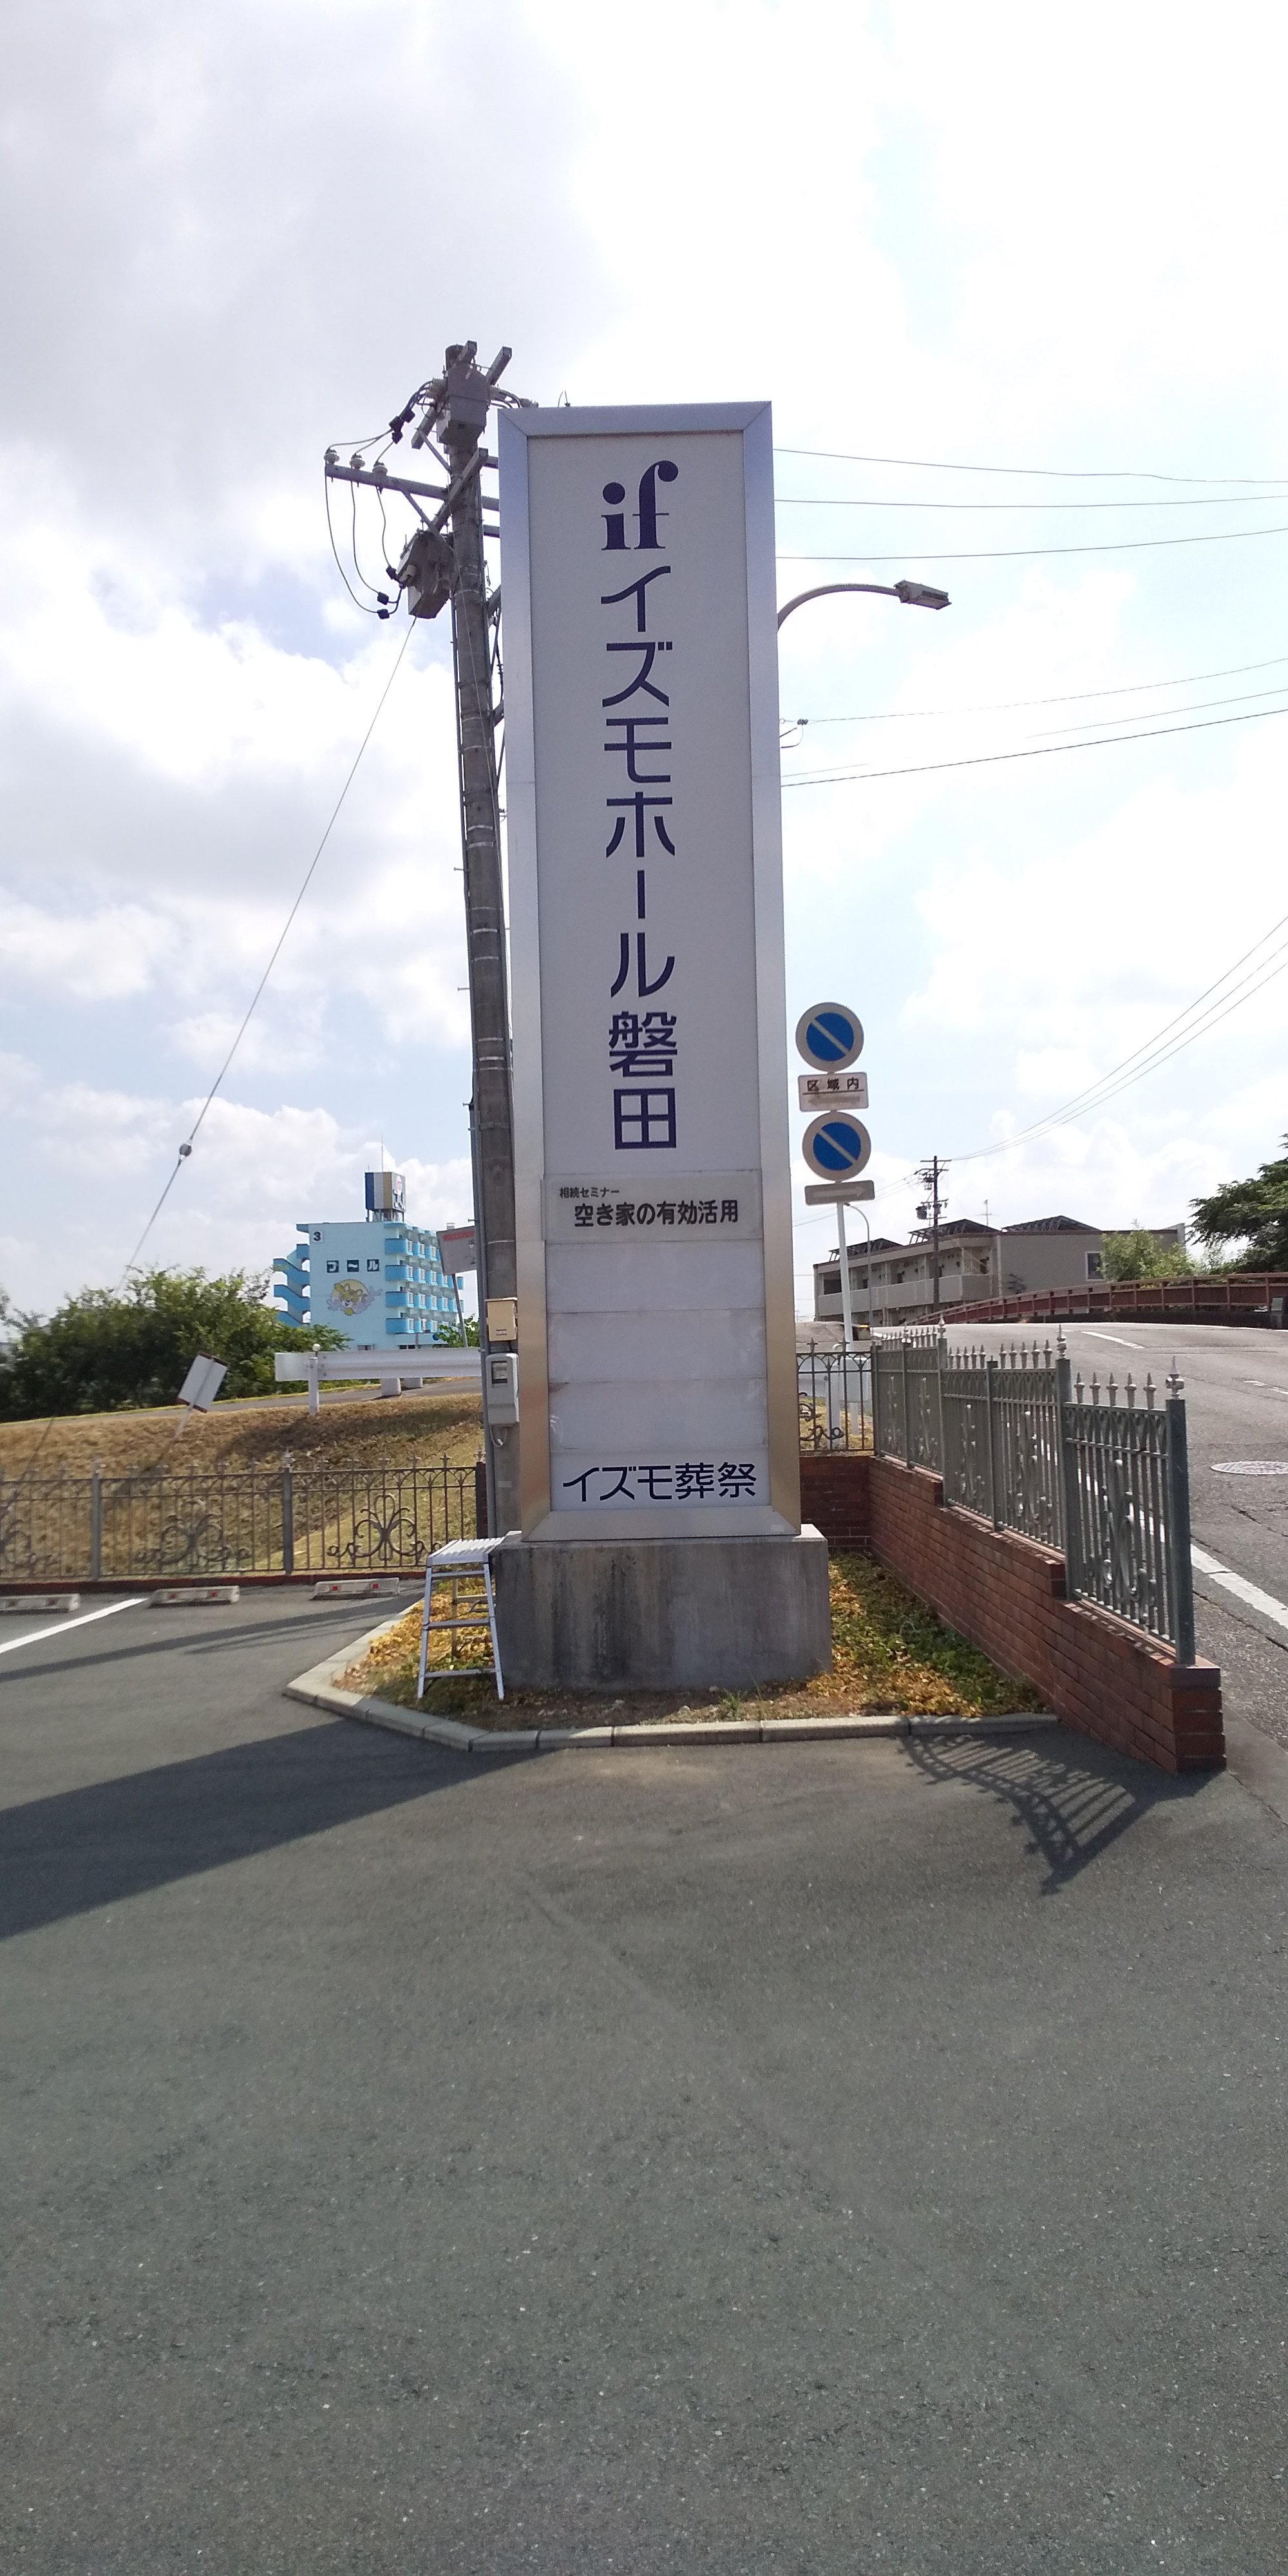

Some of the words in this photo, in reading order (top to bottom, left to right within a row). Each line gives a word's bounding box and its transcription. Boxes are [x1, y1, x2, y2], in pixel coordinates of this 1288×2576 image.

[600, 460, 679, 551] if
[600, 565, 678, 1150] イズモホール磐田
[807, 1077, 859, 1092] 区域内
[559, 1186, 620, 1199] 相続セミナー
[574, 1199, 739, 1227] 空き家の有効活用
[313, 1231, 321, 1242] 3
[562, 1461, 757, 1502] イズモ葬祭
